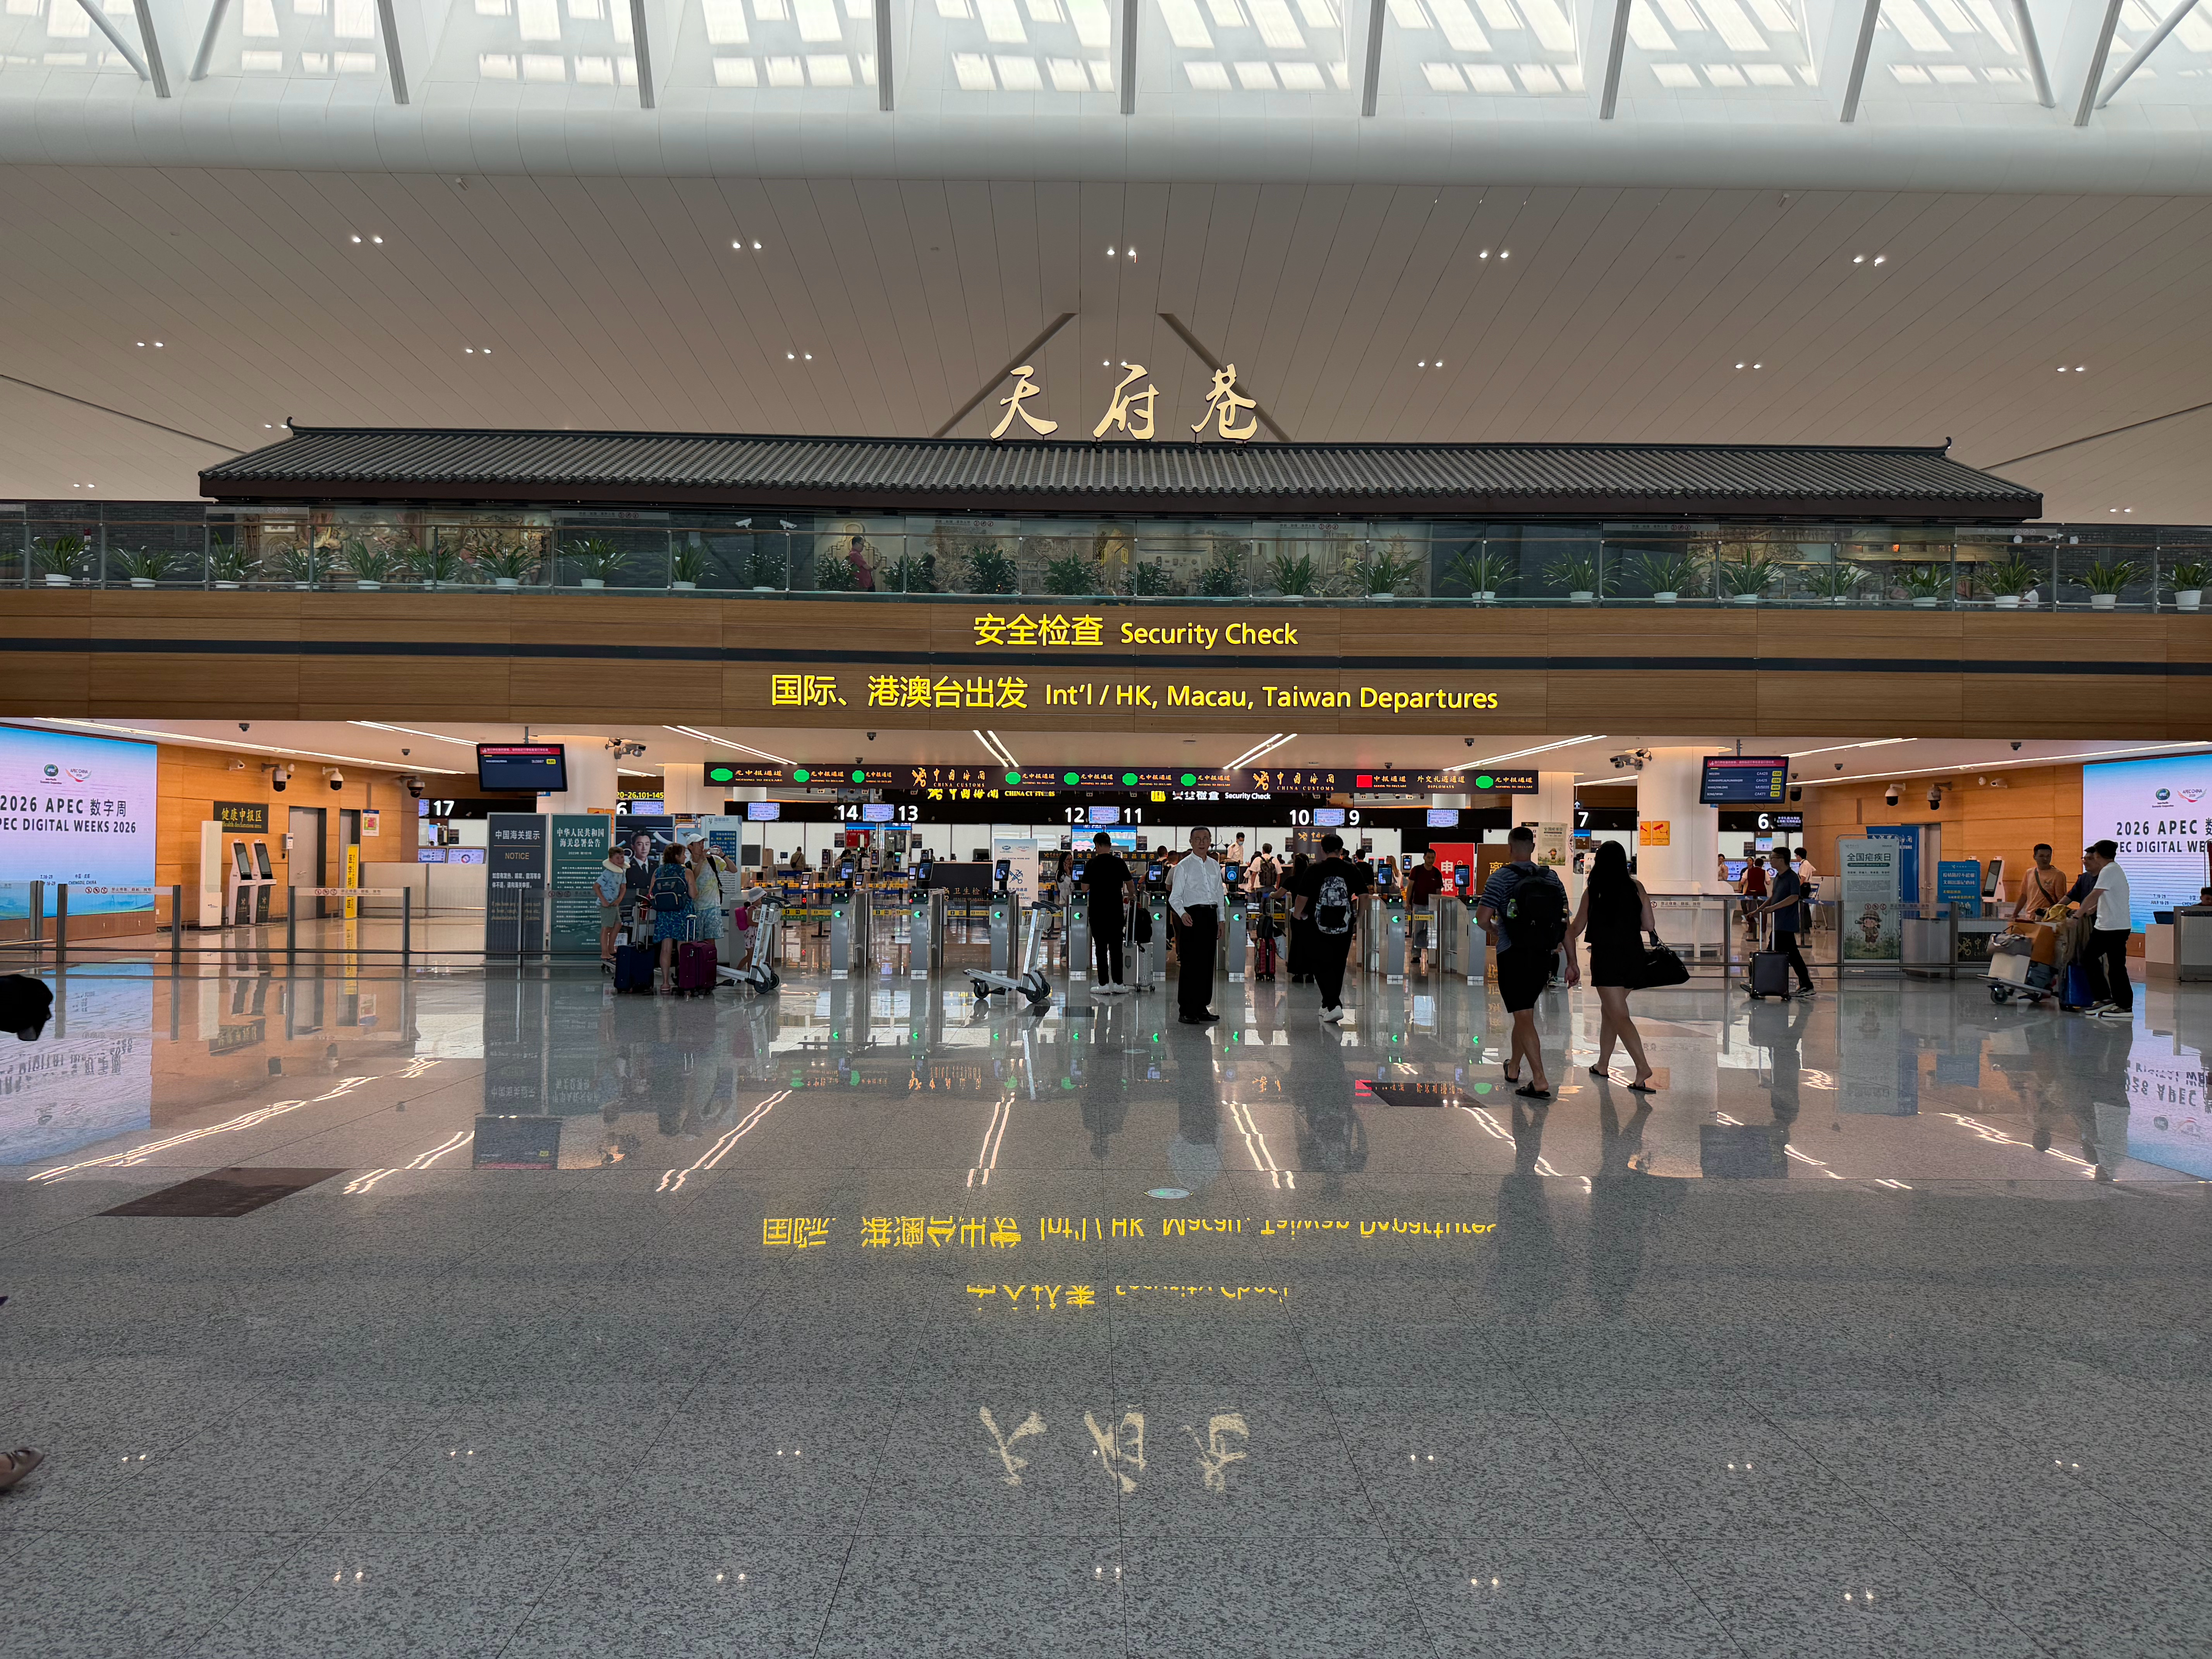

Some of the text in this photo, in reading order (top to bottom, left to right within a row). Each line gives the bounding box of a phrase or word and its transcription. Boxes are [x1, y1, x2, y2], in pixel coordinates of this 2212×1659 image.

[990, 363, 1257, 440] 天府巷
[975, 614, 1103, 646] 安全检查
[1122, 623, 1298, 649] Security Check
[773, 676, 1028, 708] 国际、港澳台出发
[1101, 686, 1109, 704] /
[1118, 686, 1157, 709] HK,
[1168, 687, 1253, 708] Macau,
[1264, 687, 1351, 708] Taiwan
[1362, 688, 1498, 713] Departures
[1225, 792, 1251, 800] Security
[0, 795, 126, 817] 2026 APEC 数字周
[433, 800, 455, 816] 17
[838, 805, 858, 821] 14
[898, 805, 918, 821] 13
[221, 807, 262, 822] 健康申报区
[1065, 807, 1084, 823] 12
[1124, 808, 1142, 823] 11
[1290, 809, 1310, 826] 10
[1349, 810, 1360, 826] 9
[1578, 812, 1589, 827] 7
[1758, 813, 1769, 829] 6
[23, 818, 69, 831] DIGITAL
[74, 820, 109, 833] WEEKS
[113, 821, 136, 833] 2026
[557, 828, 604, 837] 中华人民共和国
[2116, 821, 2149, 835] 2026
[2157, 820, 2197, 835] APEC
[495, 830, 540, 840] 中国海关提示
[560, 838, 601, 847] 海关总署公告
[2136, 841, 2182, 853] DIGITAL
[1847, 852, 1891, 861] 全国疟疾日
[1441, 860, 1453, 892] 申报
[953, 886, 989, 895] 卫生检
